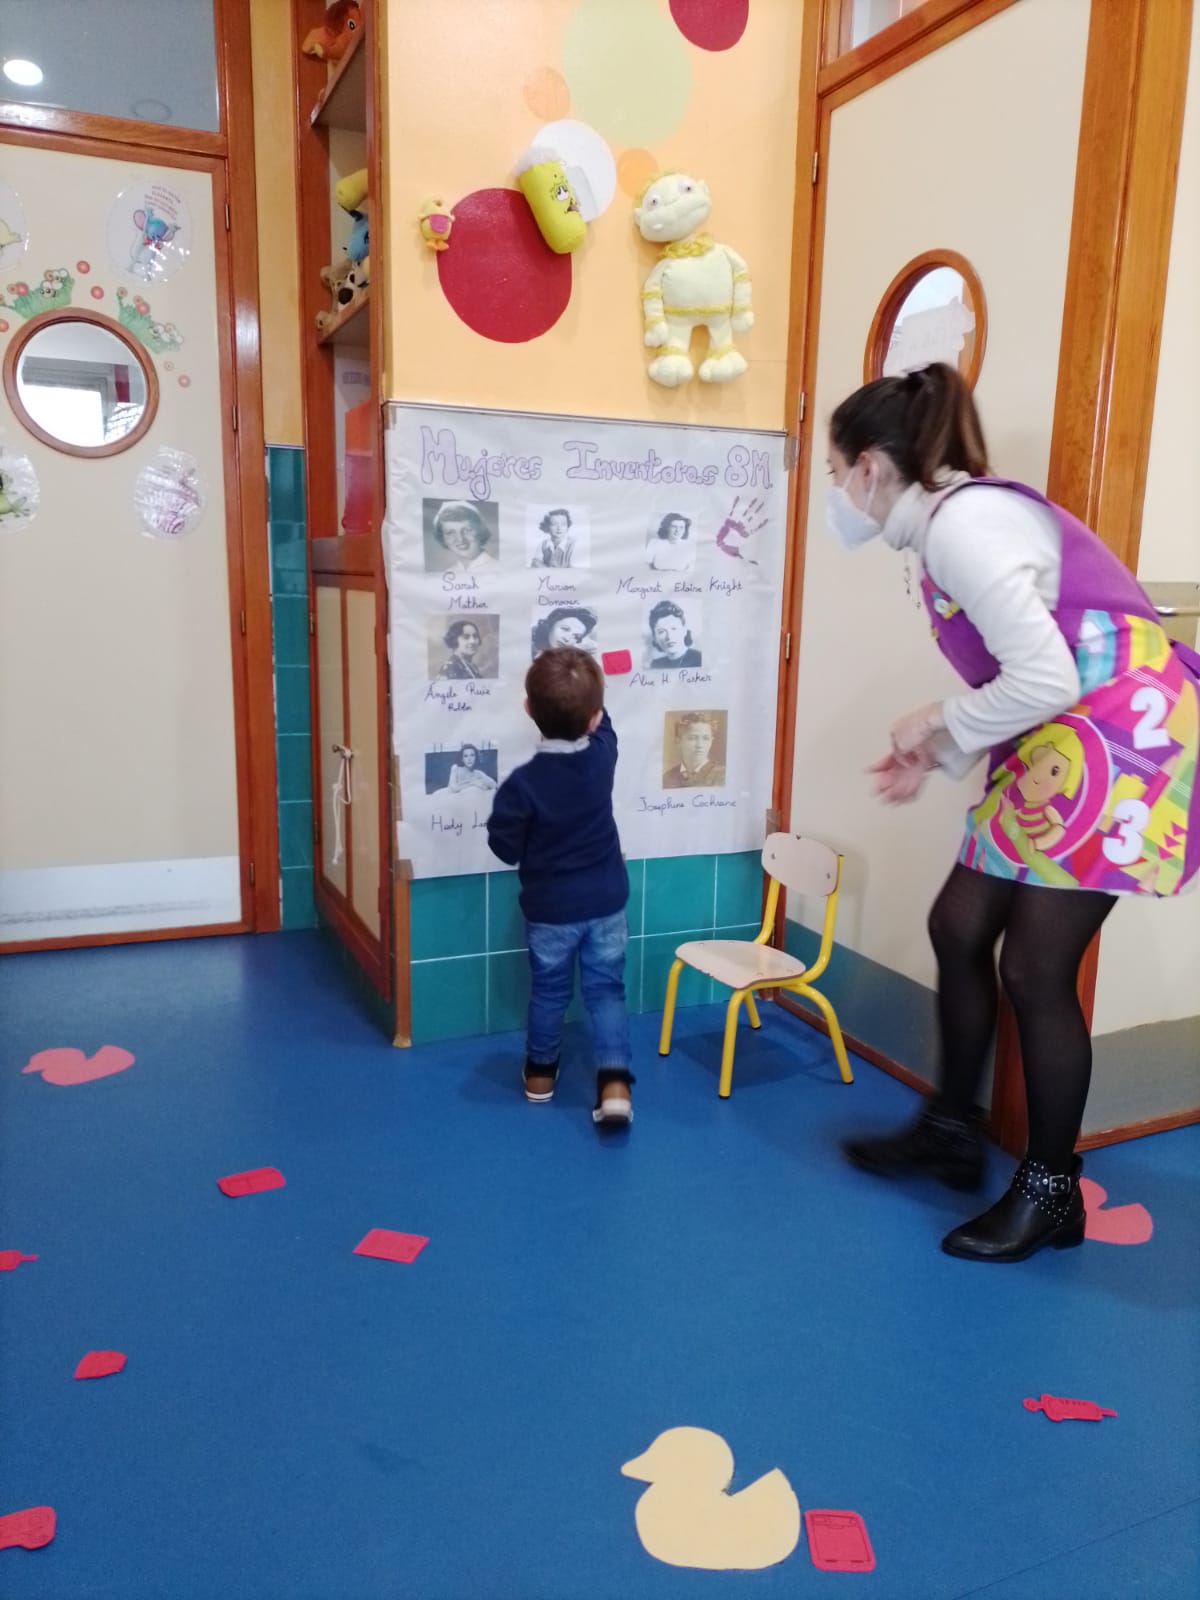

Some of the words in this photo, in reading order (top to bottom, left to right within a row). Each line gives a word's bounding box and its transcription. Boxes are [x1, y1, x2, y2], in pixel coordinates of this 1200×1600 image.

[419, 425, 543, 501] Mujeres
[563, 440, 719, 486] Inventoras
[442, 571, 479, 592] Sarah
[709, 576, 743, 597] Knight
[678, 669, 712, 685] Parker
[1130, 687, 1171, 750] 2
[1102, 798, 1151, 865] 3
